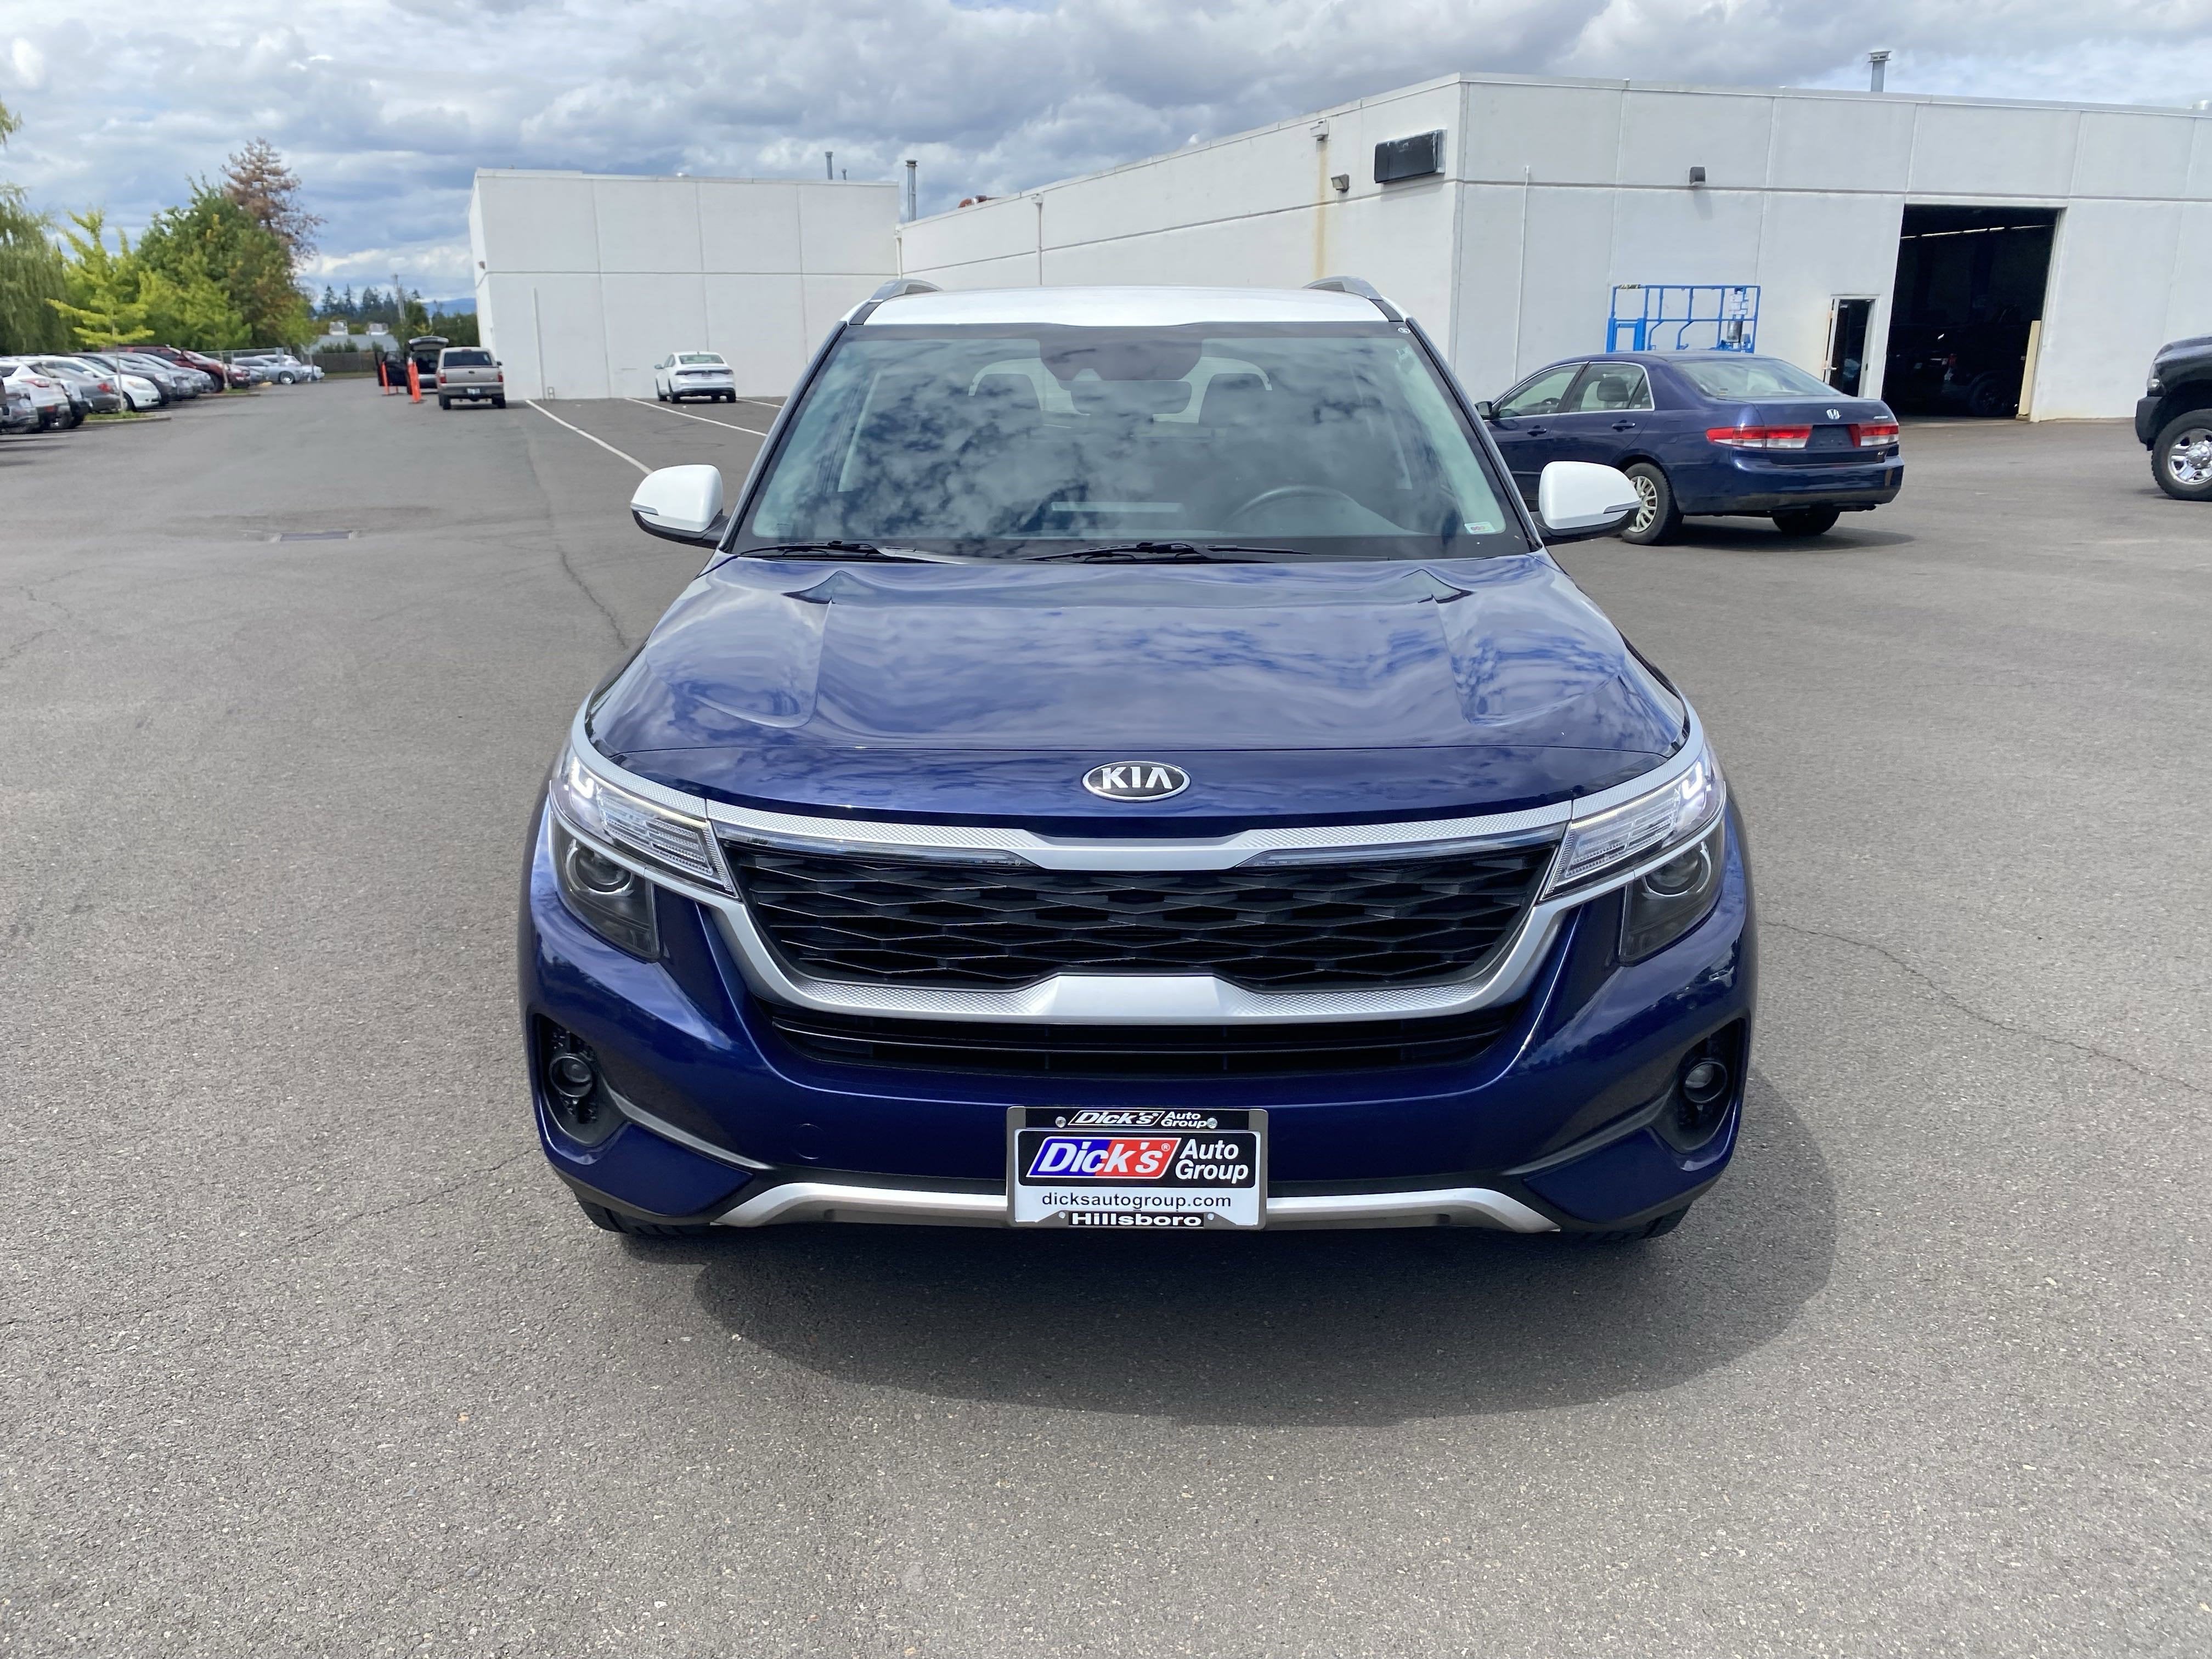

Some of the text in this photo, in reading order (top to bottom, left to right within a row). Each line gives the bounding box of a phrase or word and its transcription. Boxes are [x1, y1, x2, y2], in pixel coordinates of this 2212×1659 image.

[1101, 766, 1173, 789] KIA
[1161, 1119, 1207, 1128] Group
[1164, 1111, 1201, 1120] Auto
[1179, 1138, 1239, 1159] Auto
[1175, 1159, 1249, 1184] Group
[1042, 1192, 1232, 1211] dicksautogroup.com
[1071, 1212, 1202, 1226] Hillsboro
